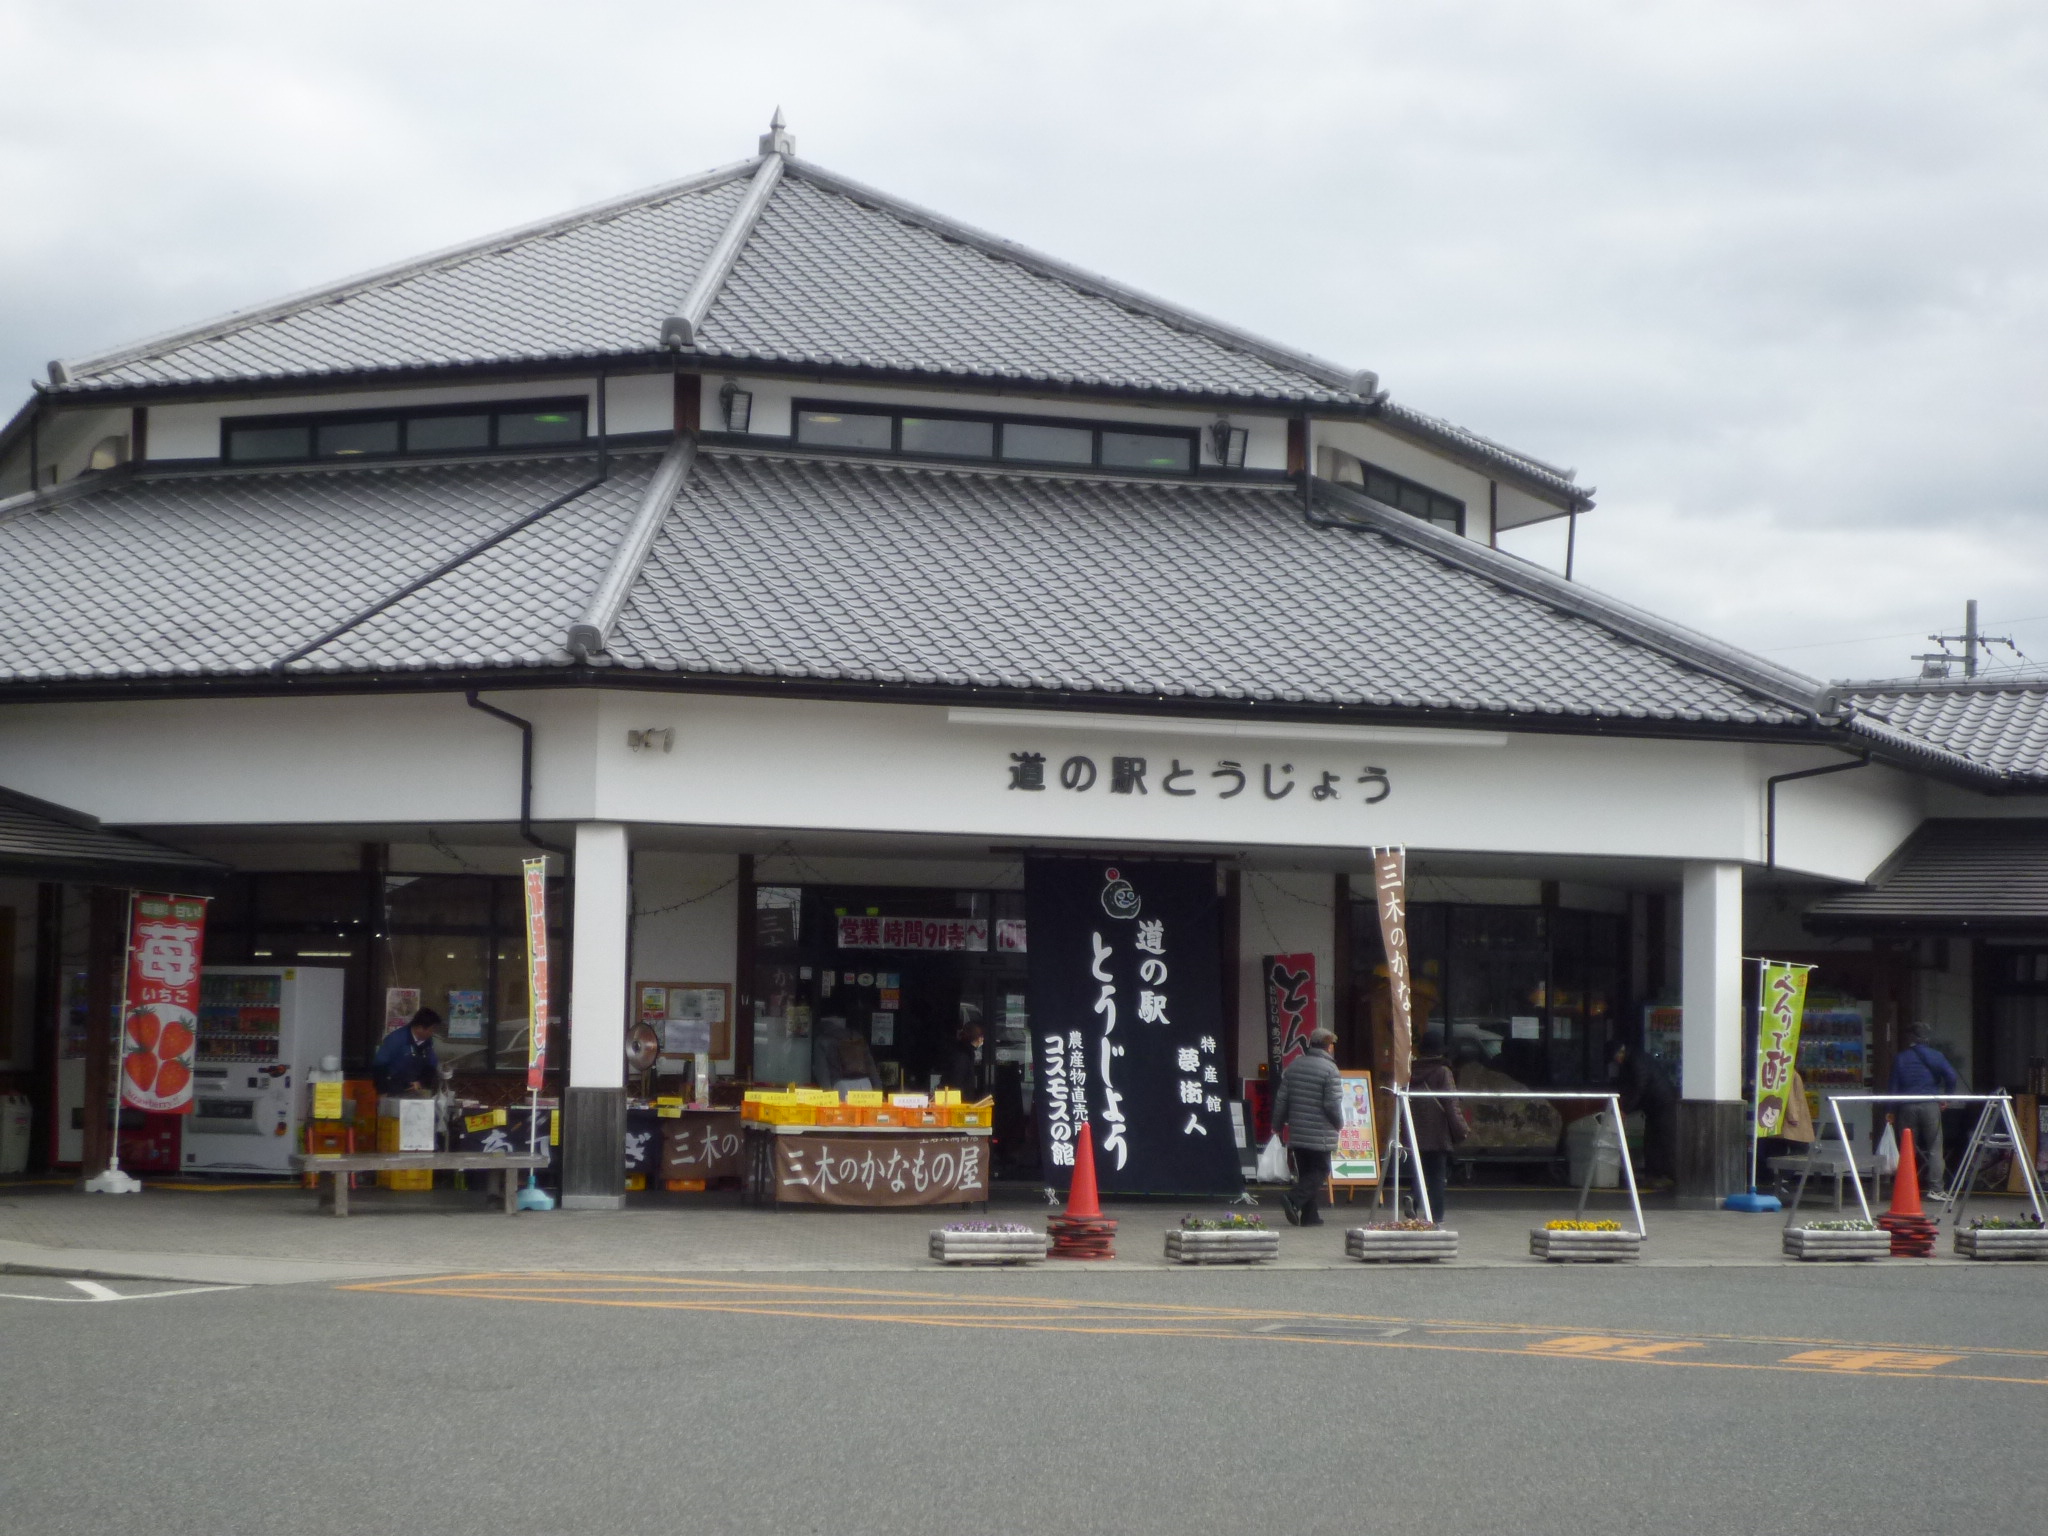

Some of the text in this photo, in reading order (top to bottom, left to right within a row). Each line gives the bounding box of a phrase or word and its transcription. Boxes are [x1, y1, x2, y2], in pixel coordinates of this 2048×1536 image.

[1008, 752, 1391, 804] 道の駅とうじょう
[136, 922, 198, 987] 苺
[1135, 919, 1170, 1025] 道の駅
[142, 987, 189, 1003] いちご
[1271, 964, 1311, 1056] とん
[1761, 975, 1796, 1090] べんりで酢
[1092, 931, 1128, 1171] とうじょう
[1201, 1036, 1222, 1113] 特産館
[1045, 1035, 1075, 1166] コスモスの館
[671, 1125, 744, 1168] 三木の
[782, 1145, 982, 1193] 三木のかなもの屋
